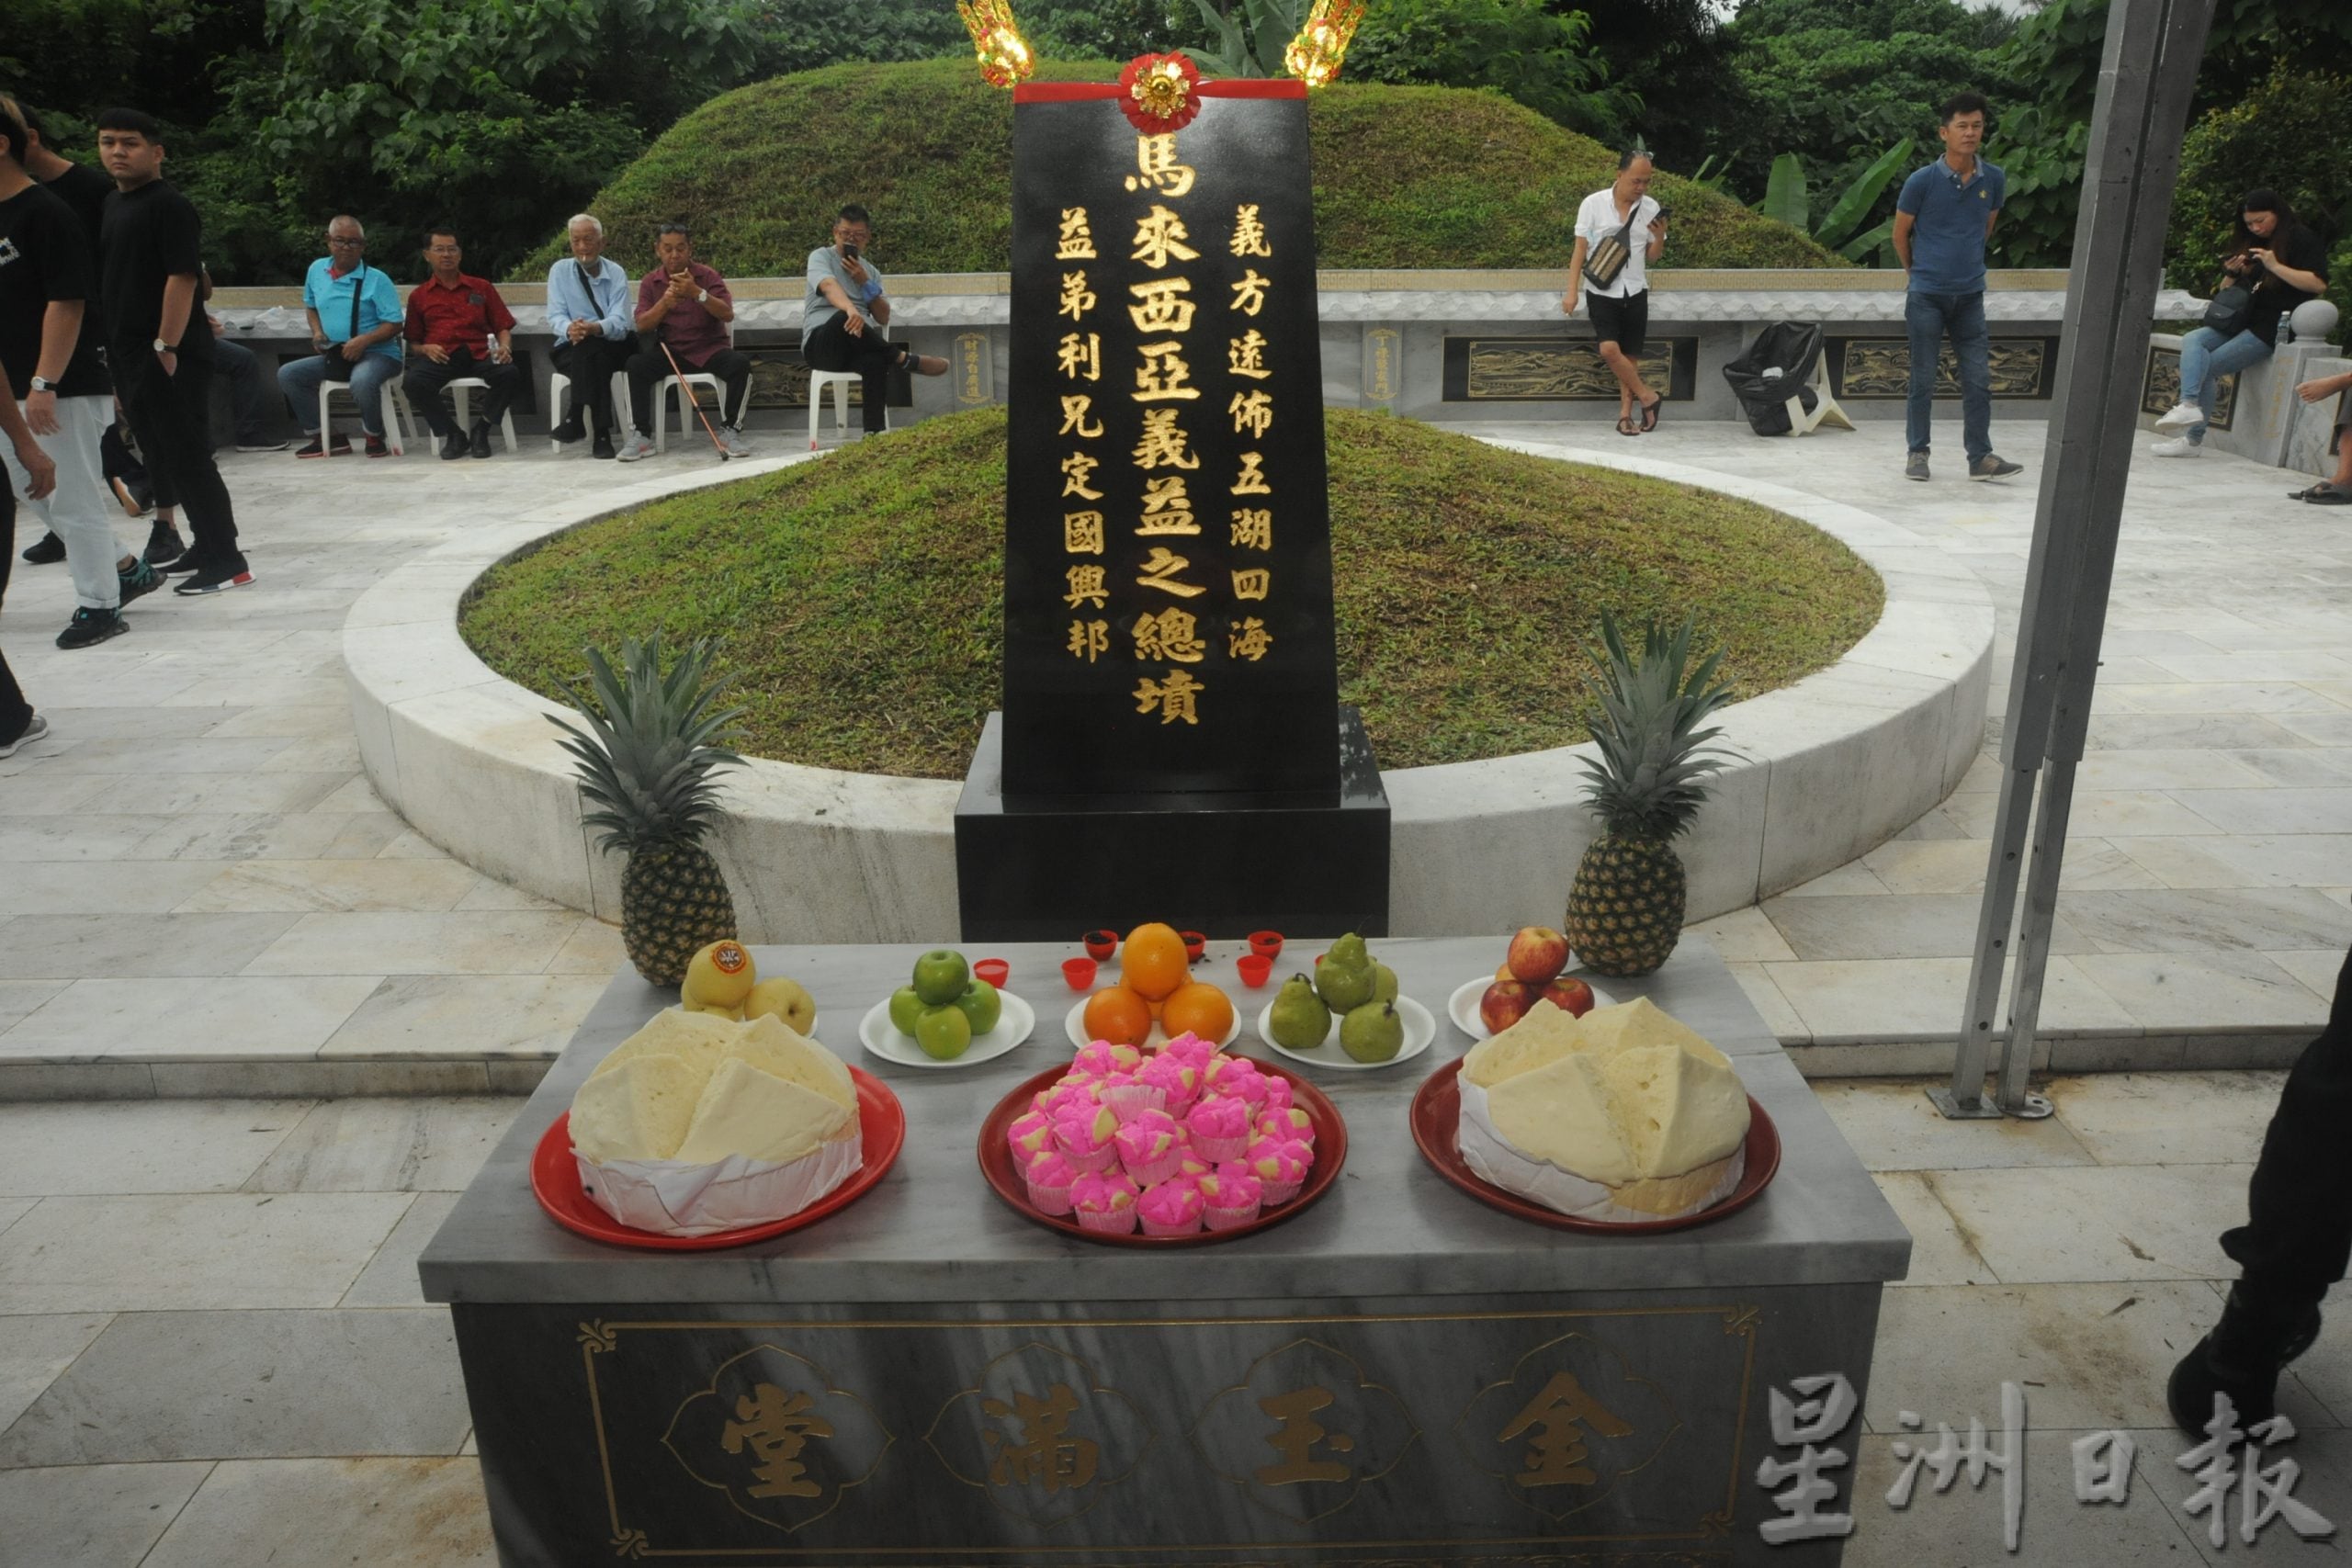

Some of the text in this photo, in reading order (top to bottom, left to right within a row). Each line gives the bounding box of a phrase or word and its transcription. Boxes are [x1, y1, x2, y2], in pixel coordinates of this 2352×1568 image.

[1056, 207, 1110, 663] 益弟利兄定國興邦
[1125, 132, 1207, 725] 馬來西亞義益之總墳
[1228, 204, 1273, 661] 義方遠佈五湖四海
